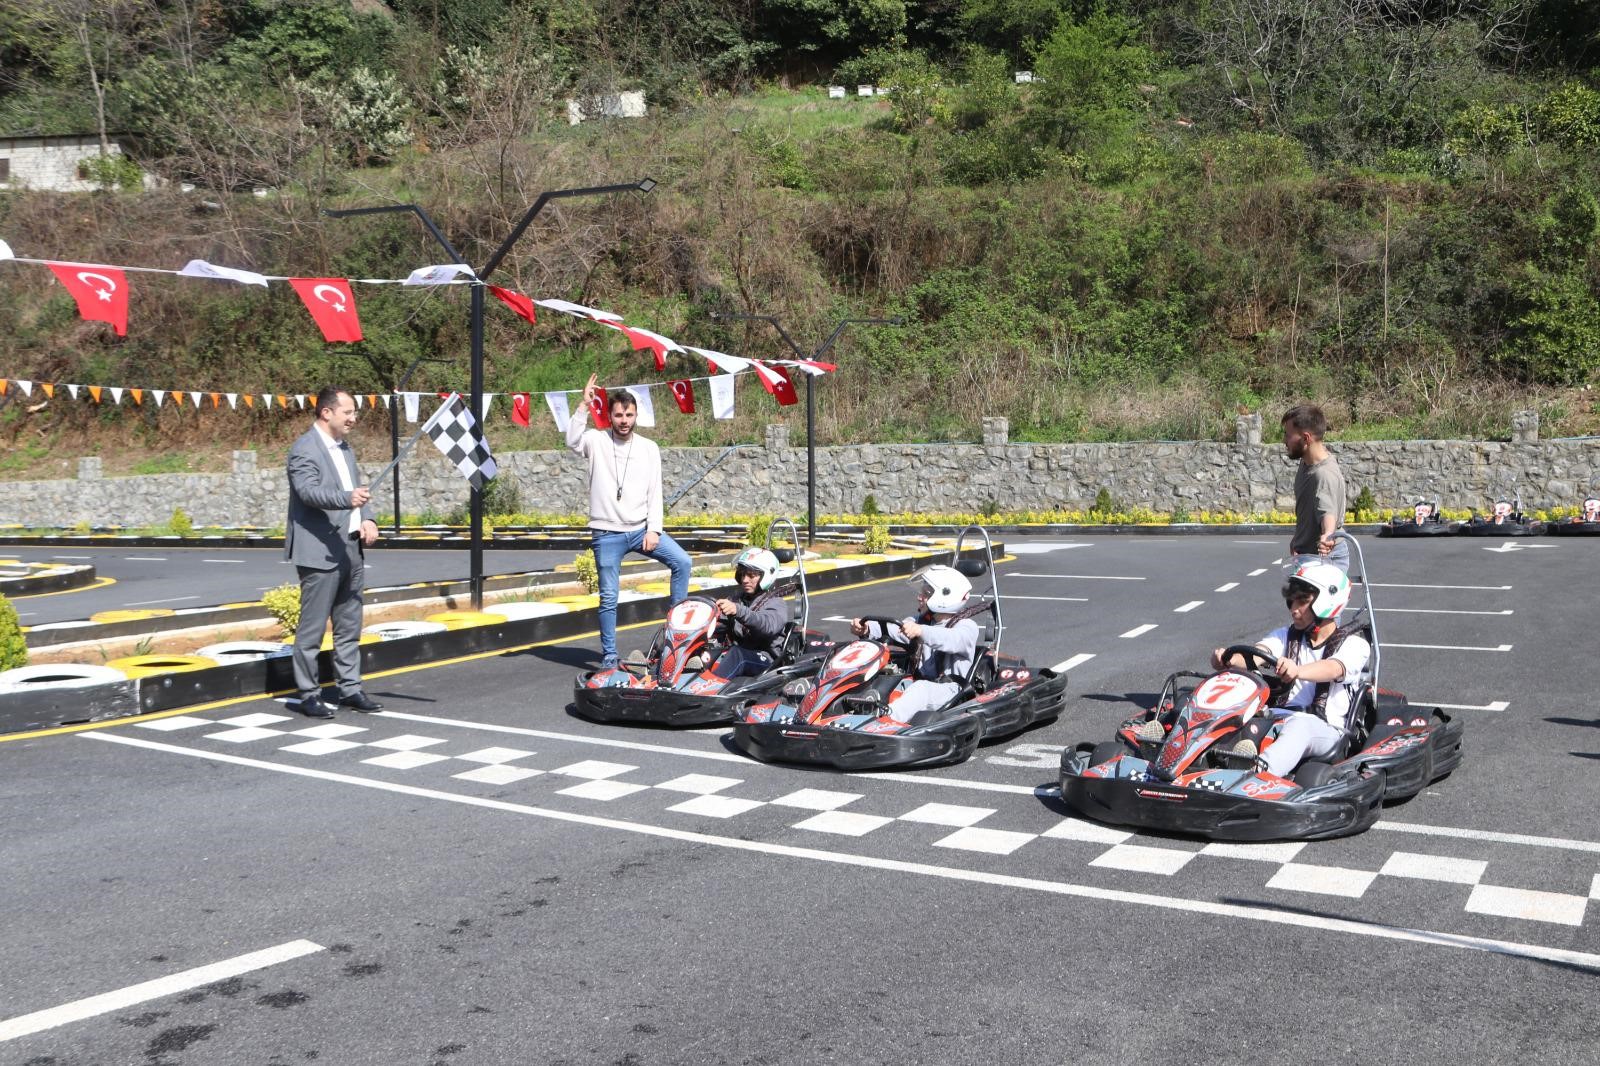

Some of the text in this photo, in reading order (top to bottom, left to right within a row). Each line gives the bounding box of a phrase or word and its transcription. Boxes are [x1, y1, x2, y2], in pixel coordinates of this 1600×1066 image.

[683, 609, 696, 625] 1
[840, 649, 864, 663] 4
[1205, 684, 1235, 704] 7
